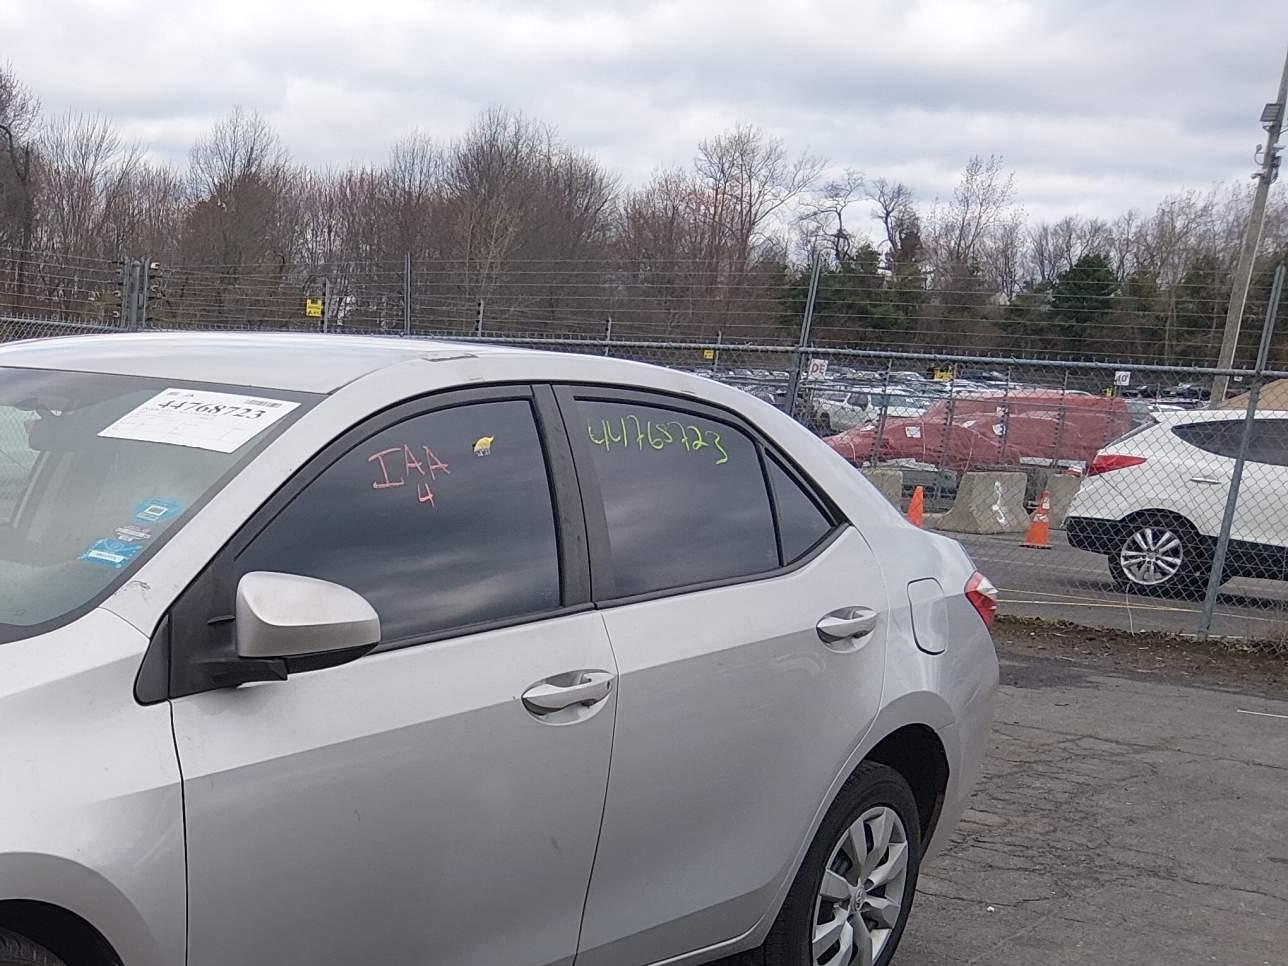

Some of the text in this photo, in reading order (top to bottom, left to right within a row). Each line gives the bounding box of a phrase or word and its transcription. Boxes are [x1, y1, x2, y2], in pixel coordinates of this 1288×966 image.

[158, 399, 267, 420] 44768723
[368, 443, 452, 490] IAA
[415, 482, 437, 509] 4
